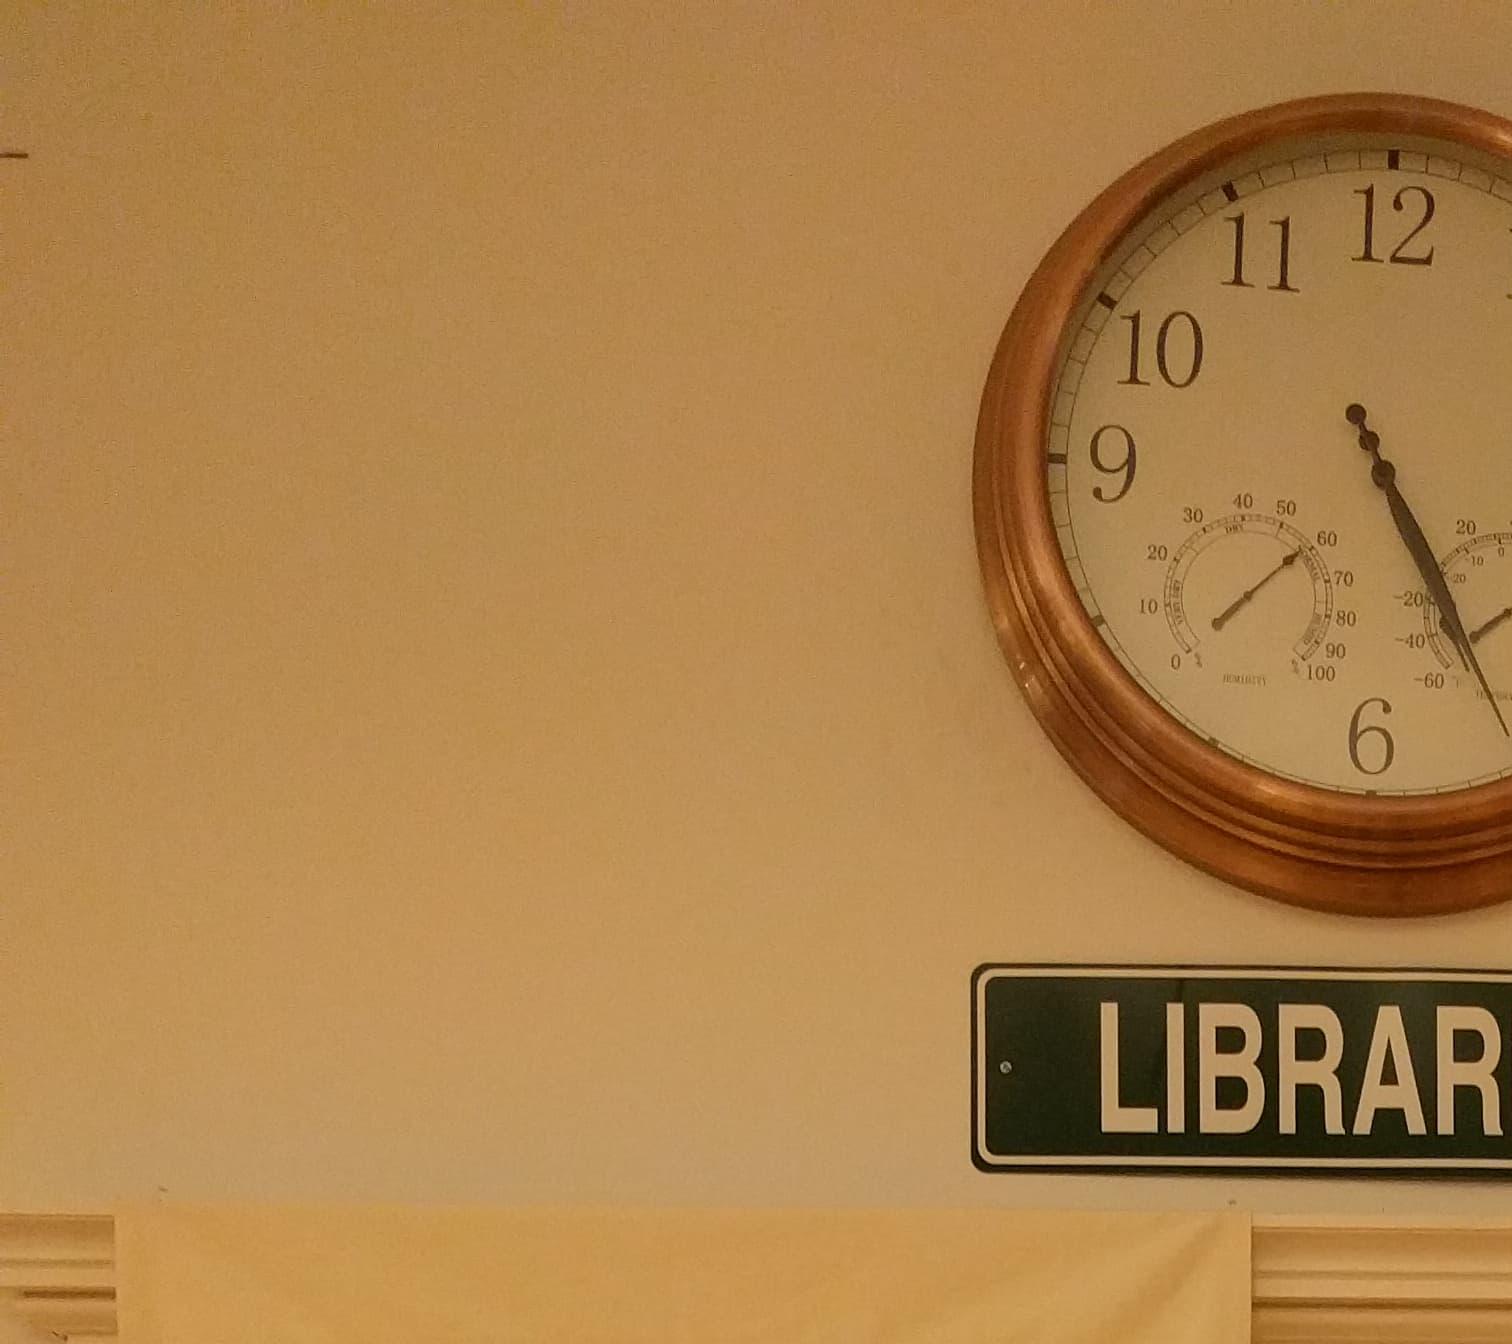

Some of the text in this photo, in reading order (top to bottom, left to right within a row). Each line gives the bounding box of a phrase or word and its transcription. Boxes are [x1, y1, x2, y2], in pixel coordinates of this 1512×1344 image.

[1351, 183, 1436, 266] 12
[1221, 212, 1300, 293] 11
[1117, 310, 1203, 388] 10
[1090, 424, 1137, 502] 9
[1233, 493, 1253, 509] 40
[1276, 500, 1297, 517] 50
[1183, 507, 1203, 523] 30
[1456, 519, 1477, 535] 20
[1317, 530, 1337, 547] 60
[1147, 545, 1168, 561] 20
[1334, 570, 1354, 587] 70
[1140, 599, 1158, 614] 10
[1393, 590, 1424, 607] -20
[1336, 610, 1356, 627] 80
[1395, 632, 1426, 649] -40
[1326, 643, 1346, 659] 90
[1171, 654, 1181, 670] 0
[1306, 665, 1336, 682] 100
[1414, 672, 1444, 689] -60
[1349, 697, 1395, 775] 6
